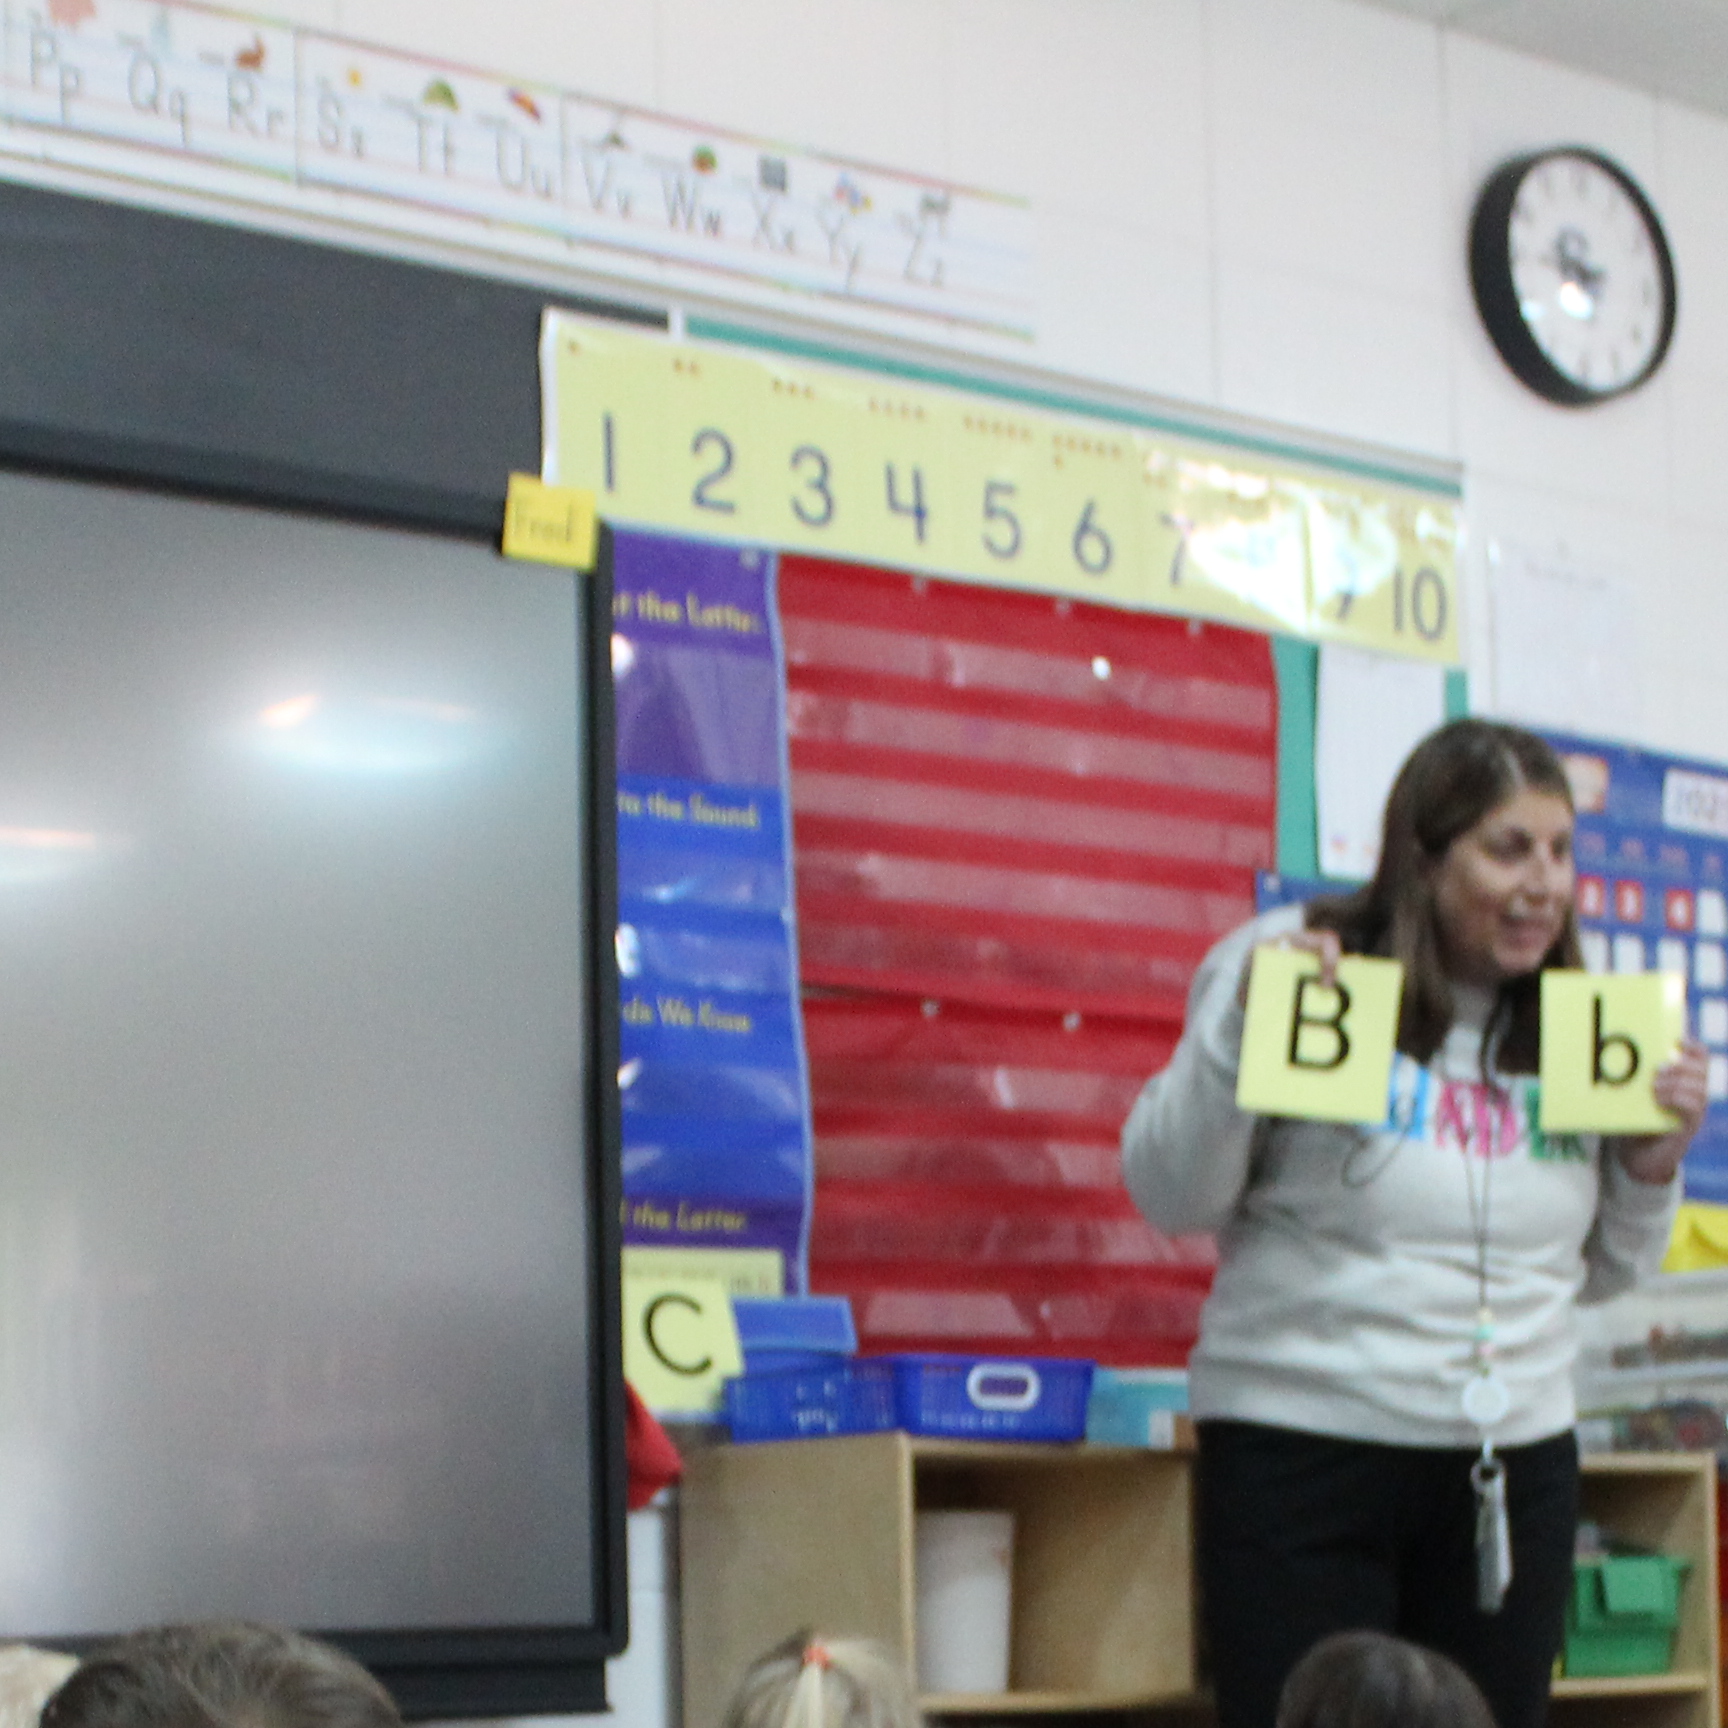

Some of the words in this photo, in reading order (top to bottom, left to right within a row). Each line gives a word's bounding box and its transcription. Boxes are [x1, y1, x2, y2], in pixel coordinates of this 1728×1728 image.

[29, 26, 83, 126] Pp
[226, 72, 284, 138] Rr
[493, 128, 555, 201] Uu
[661, 168, 724, 238] Ww
[818, 204, 862, 292] Yy
[691, 426, 736, 516] 2
[789, 444, 835, 528] 3
[885, 460, 928, 545] 4
[980, 479, 1022, 560] 5
[1072, 498, 1114, 575] 6
[1158, 512, 1196, 586] 7
[1392, 565, 1448, 642] 10
[1286, 974, 1352, 1071] B
[1588, 994, 1640, 1086] b
[640, 1294, 713, 1376] C
